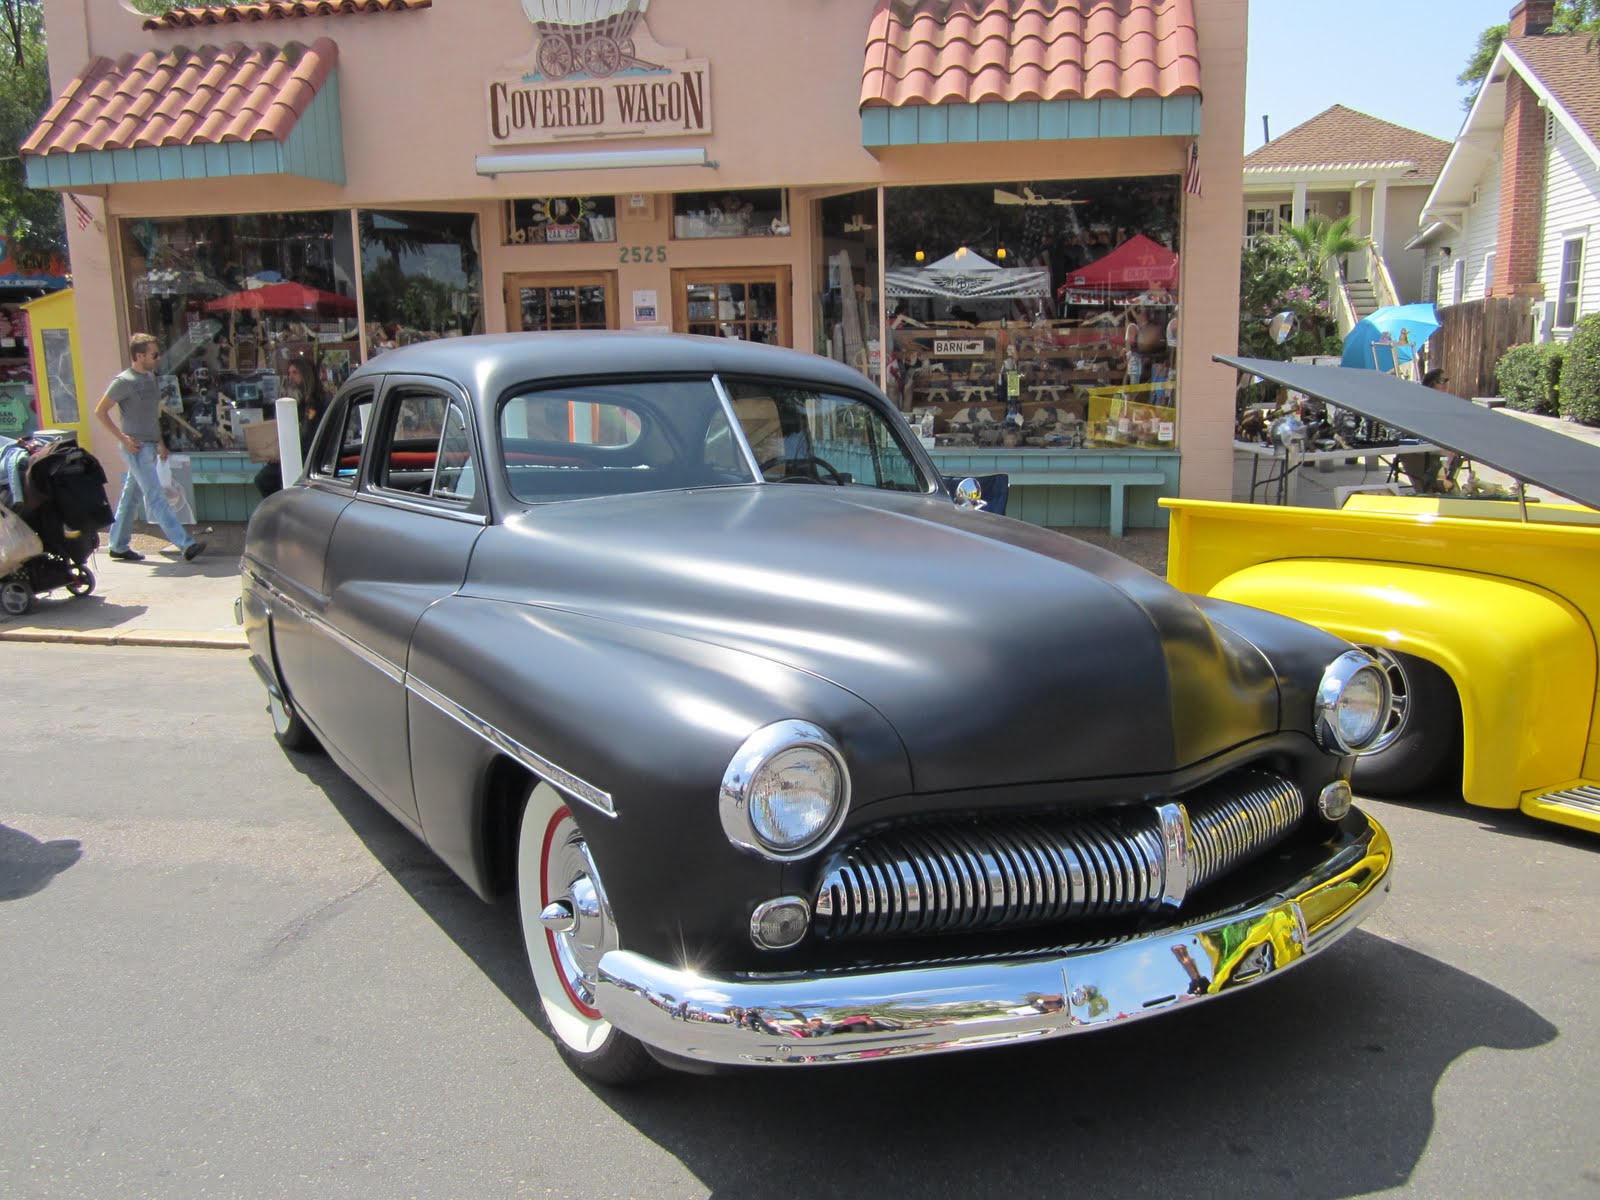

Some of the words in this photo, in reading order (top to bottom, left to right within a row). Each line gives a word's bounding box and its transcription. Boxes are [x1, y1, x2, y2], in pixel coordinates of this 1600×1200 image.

[490, 82, 605, 140] COVERED
[613, 71, 705, 129] WAGON
[619, 245, 667, 263] 2525
[936, 342, 963, 352] BARN
